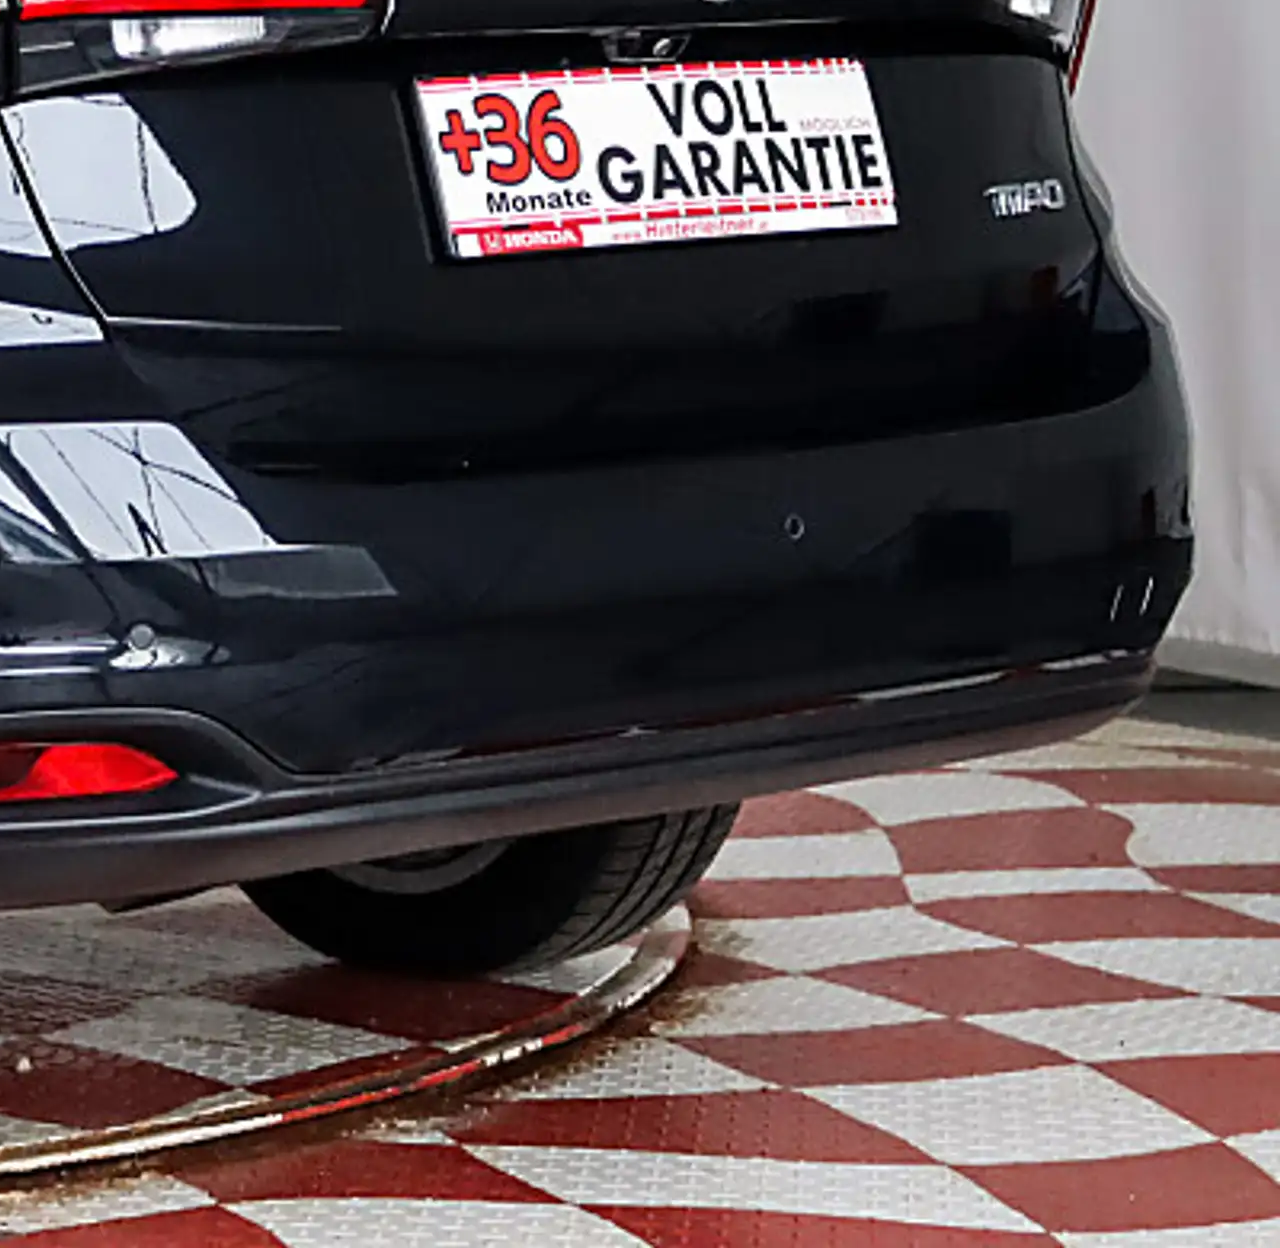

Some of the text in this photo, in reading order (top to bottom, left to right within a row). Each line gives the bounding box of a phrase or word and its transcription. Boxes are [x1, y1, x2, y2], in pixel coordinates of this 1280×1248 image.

[645, 78, 788, 137] VOLL
[439, 89, 580, 186] +36
[596, 134, 883, 204] GARANTIE
[487, 189, 592, 214] Monate
[983, 178, 1065, 218] TIPO
[502, 228, 580, 250] HONDA
